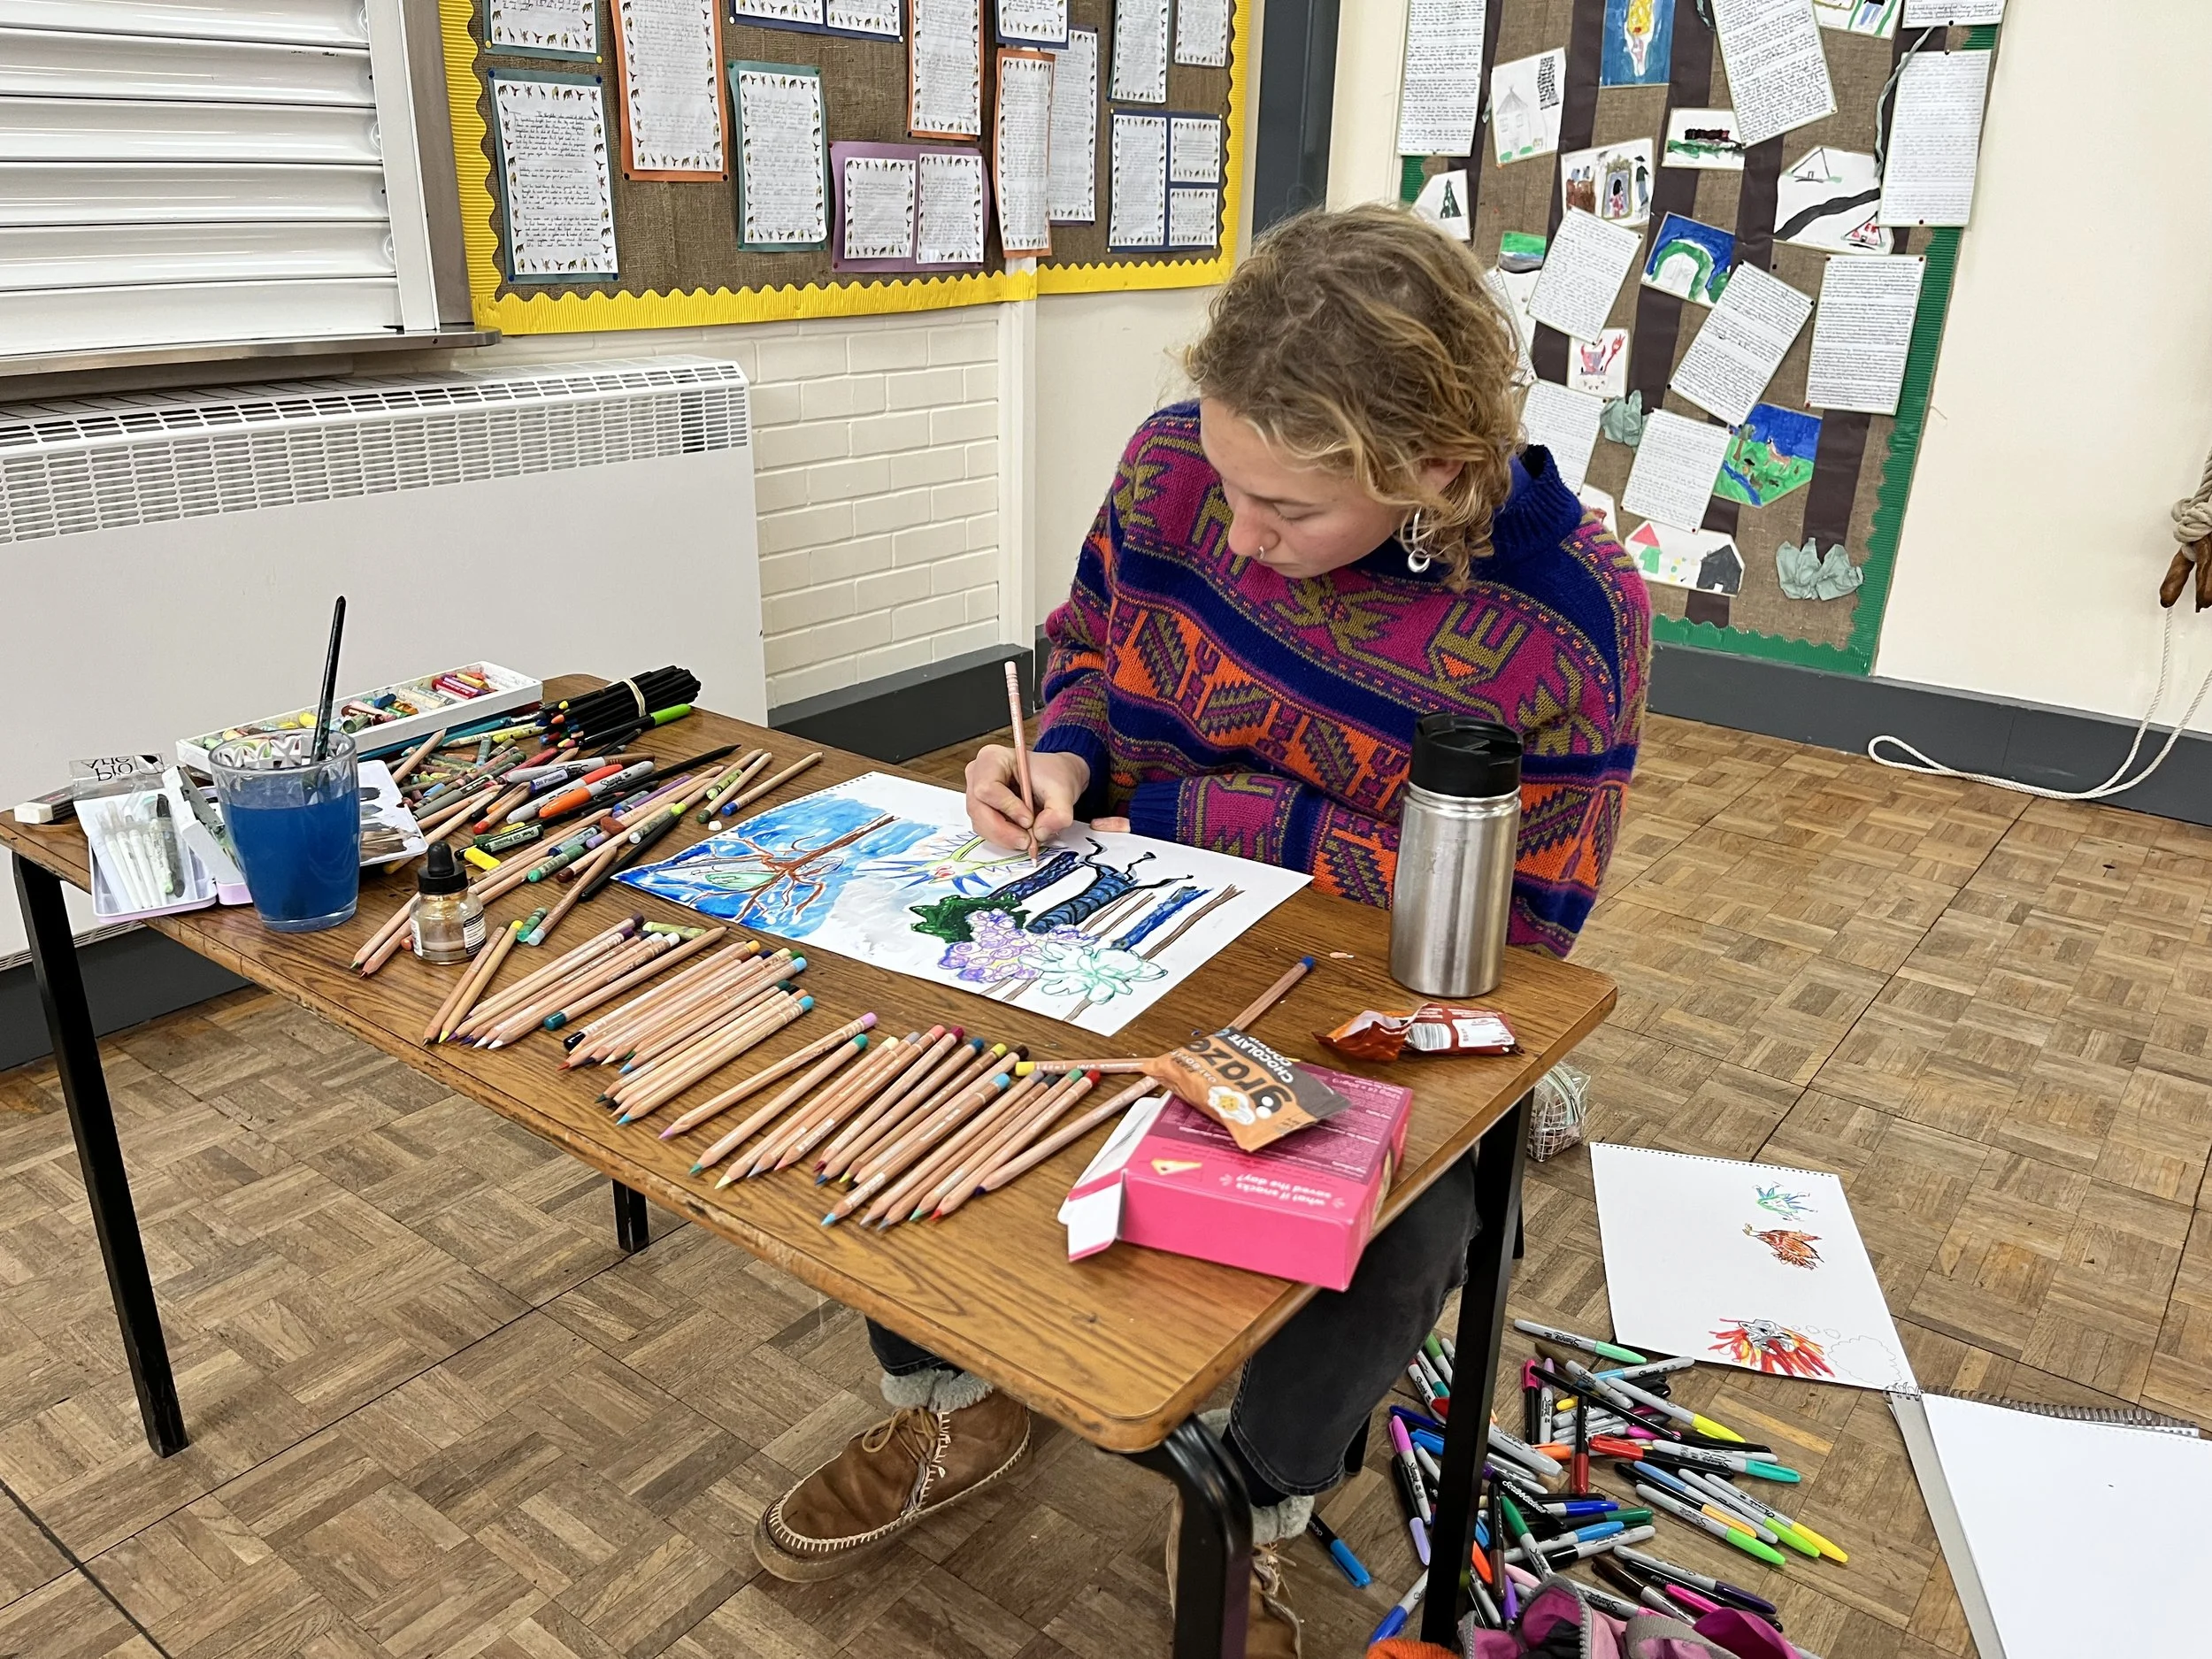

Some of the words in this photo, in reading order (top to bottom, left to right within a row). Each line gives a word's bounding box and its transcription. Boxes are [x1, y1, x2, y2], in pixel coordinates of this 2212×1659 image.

[1226, 1033, 1294, 1085] CHOCOLATE
[1183, 1038, 1293, 1116] graze
[1235, 1173, 1268, 1186] day?
[1269, 1179, 1292, 1191] the
[1235, 1182, 1279, 1196] snacks
[1291, 1185, 1333, 1200] saved
[1279, 1192, 1292, 1201] if
[1292, 1193, 1326, 1207] what
